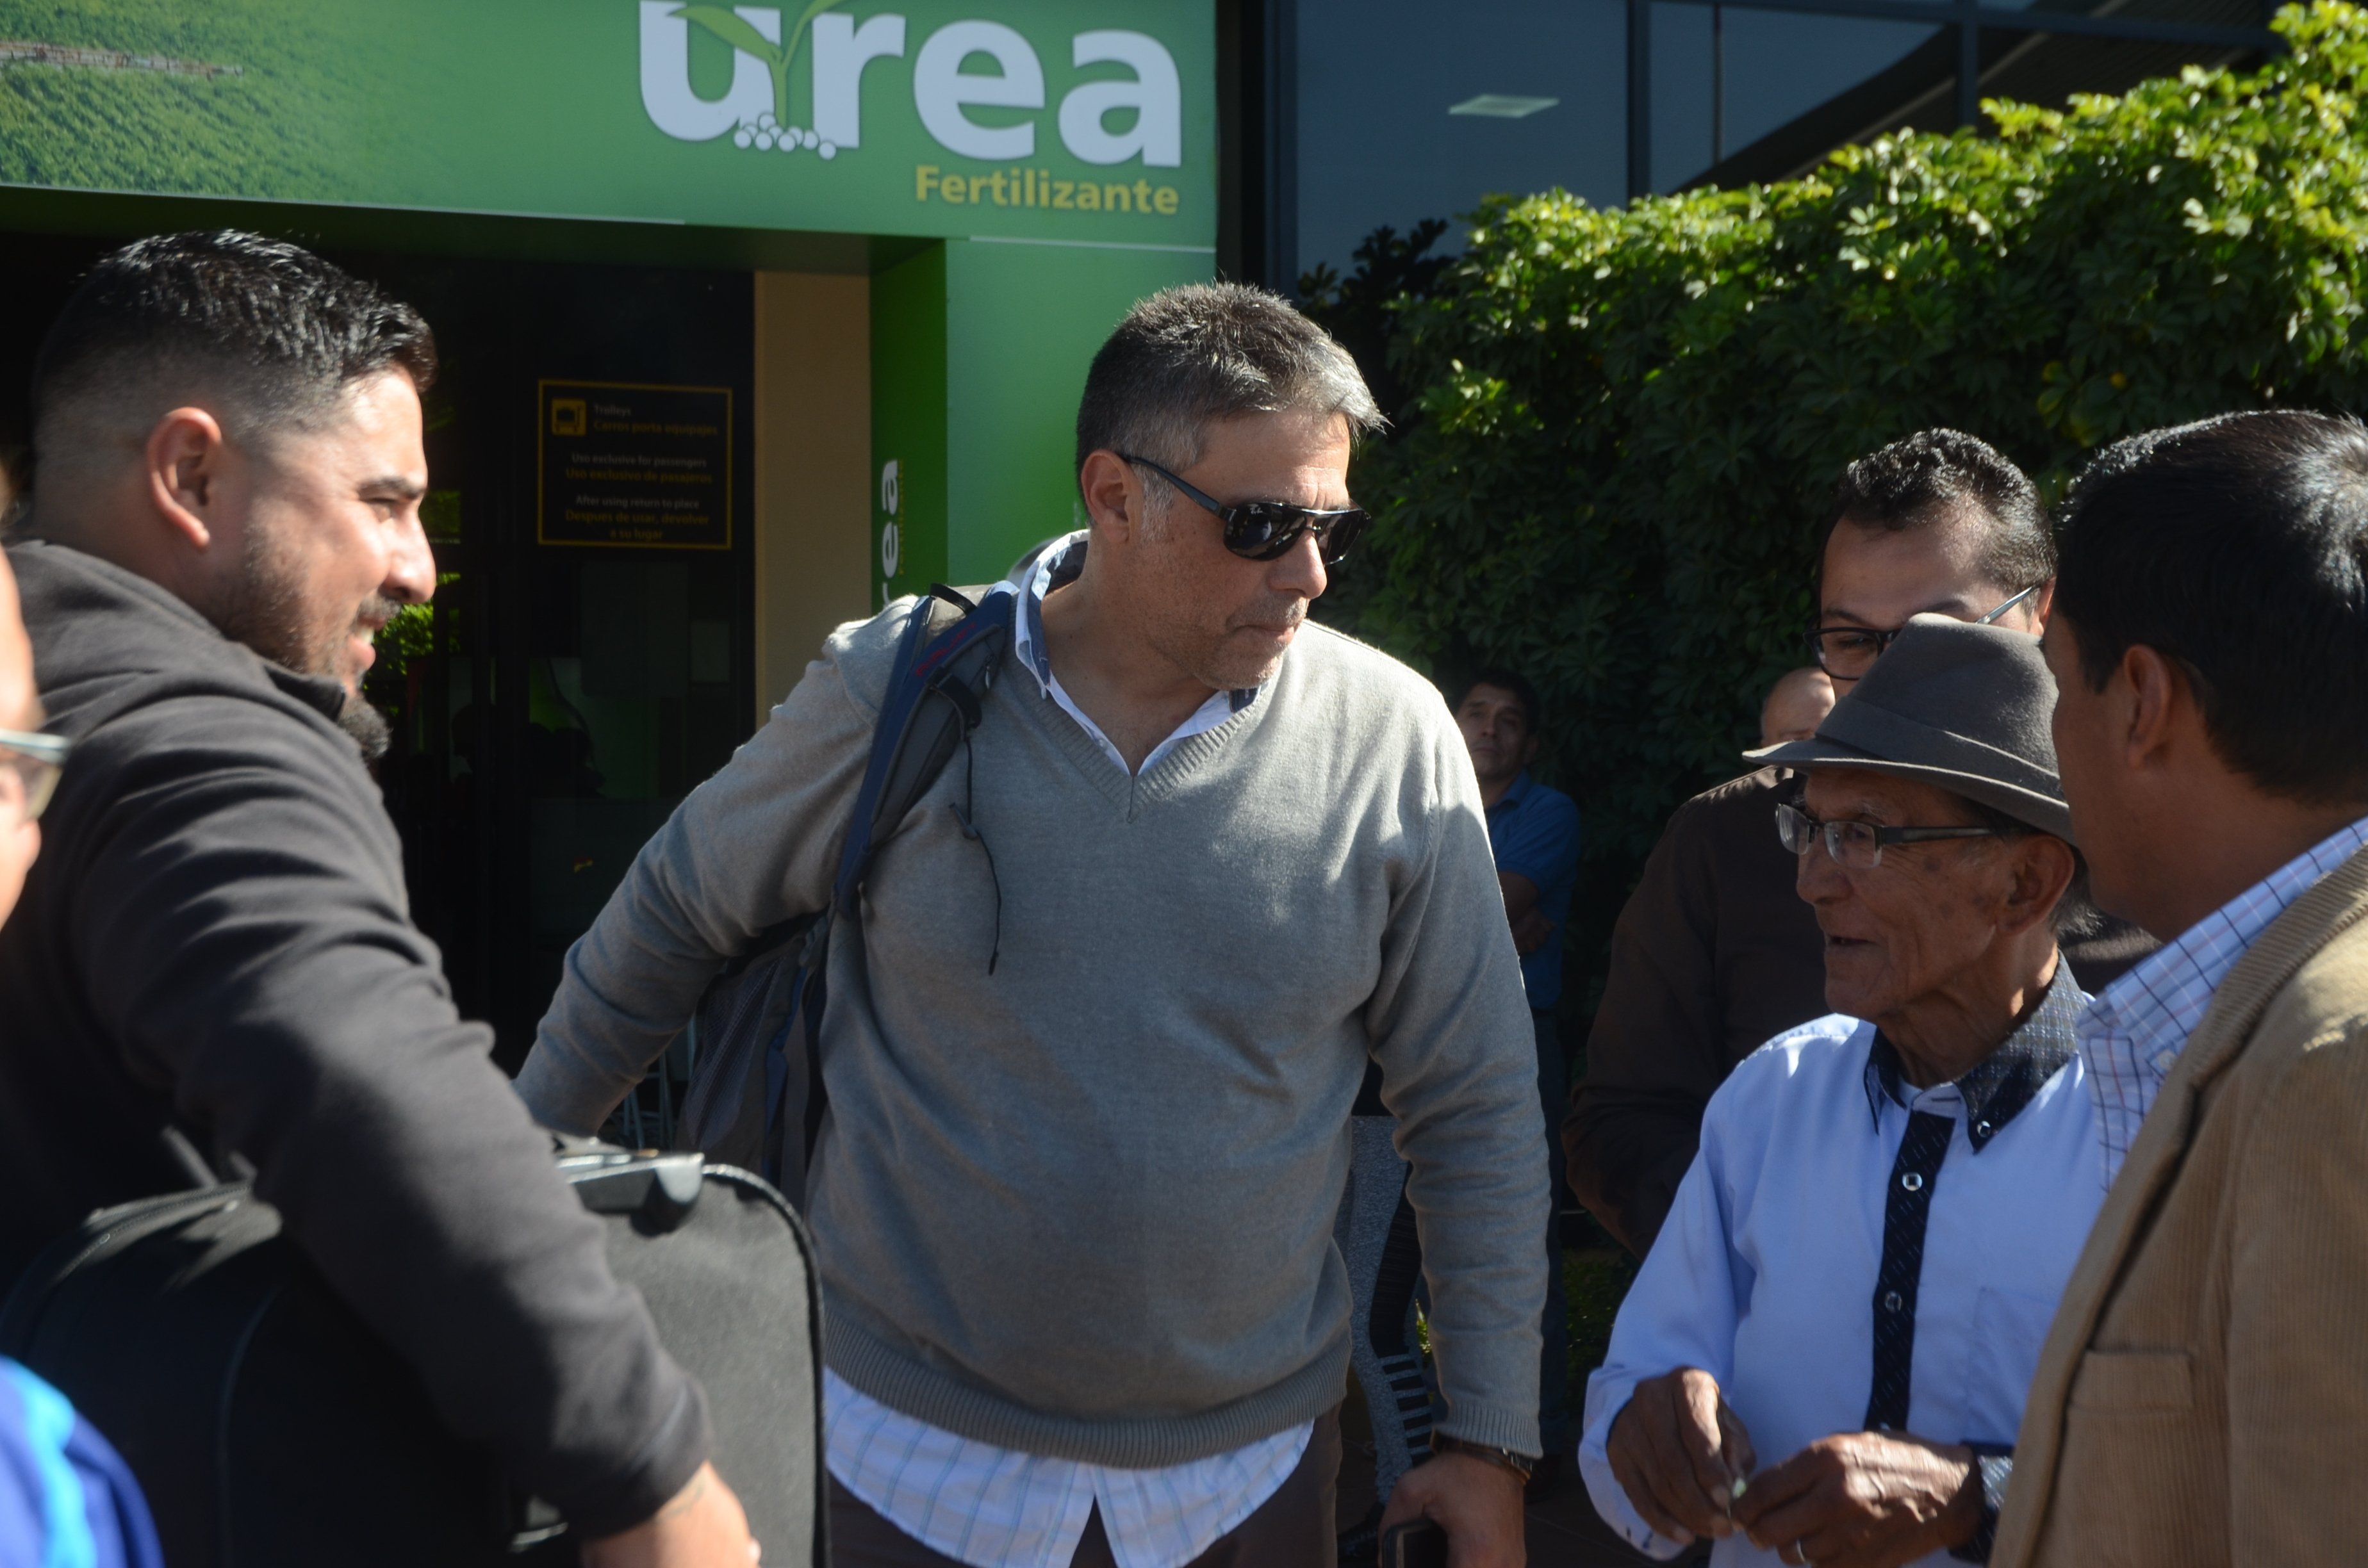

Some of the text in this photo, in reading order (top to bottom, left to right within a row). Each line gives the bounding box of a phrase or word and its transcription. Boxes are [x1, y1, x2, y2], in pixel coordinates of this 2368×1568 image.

[639, 0, 1181, 168] urea
[915, 165, 1180, 215] Fertilizante
[593, 402, 632, 417] Trolleys
[593, 420, 718, 437] Carros porta equipajes
[593, 453, 636, 466] exclusive
[638, 454, 652, 466] for
[654, 457, 707, 469] passengers
[566, 468, 713, 485] Uso exclusivo de pasajeros
[575, 494, 700, 510] After using return to place
[616, 511, 630, 523] de
[661, 512, 710, 525] devolver
[610, 528, 662, 541] a su lugar
